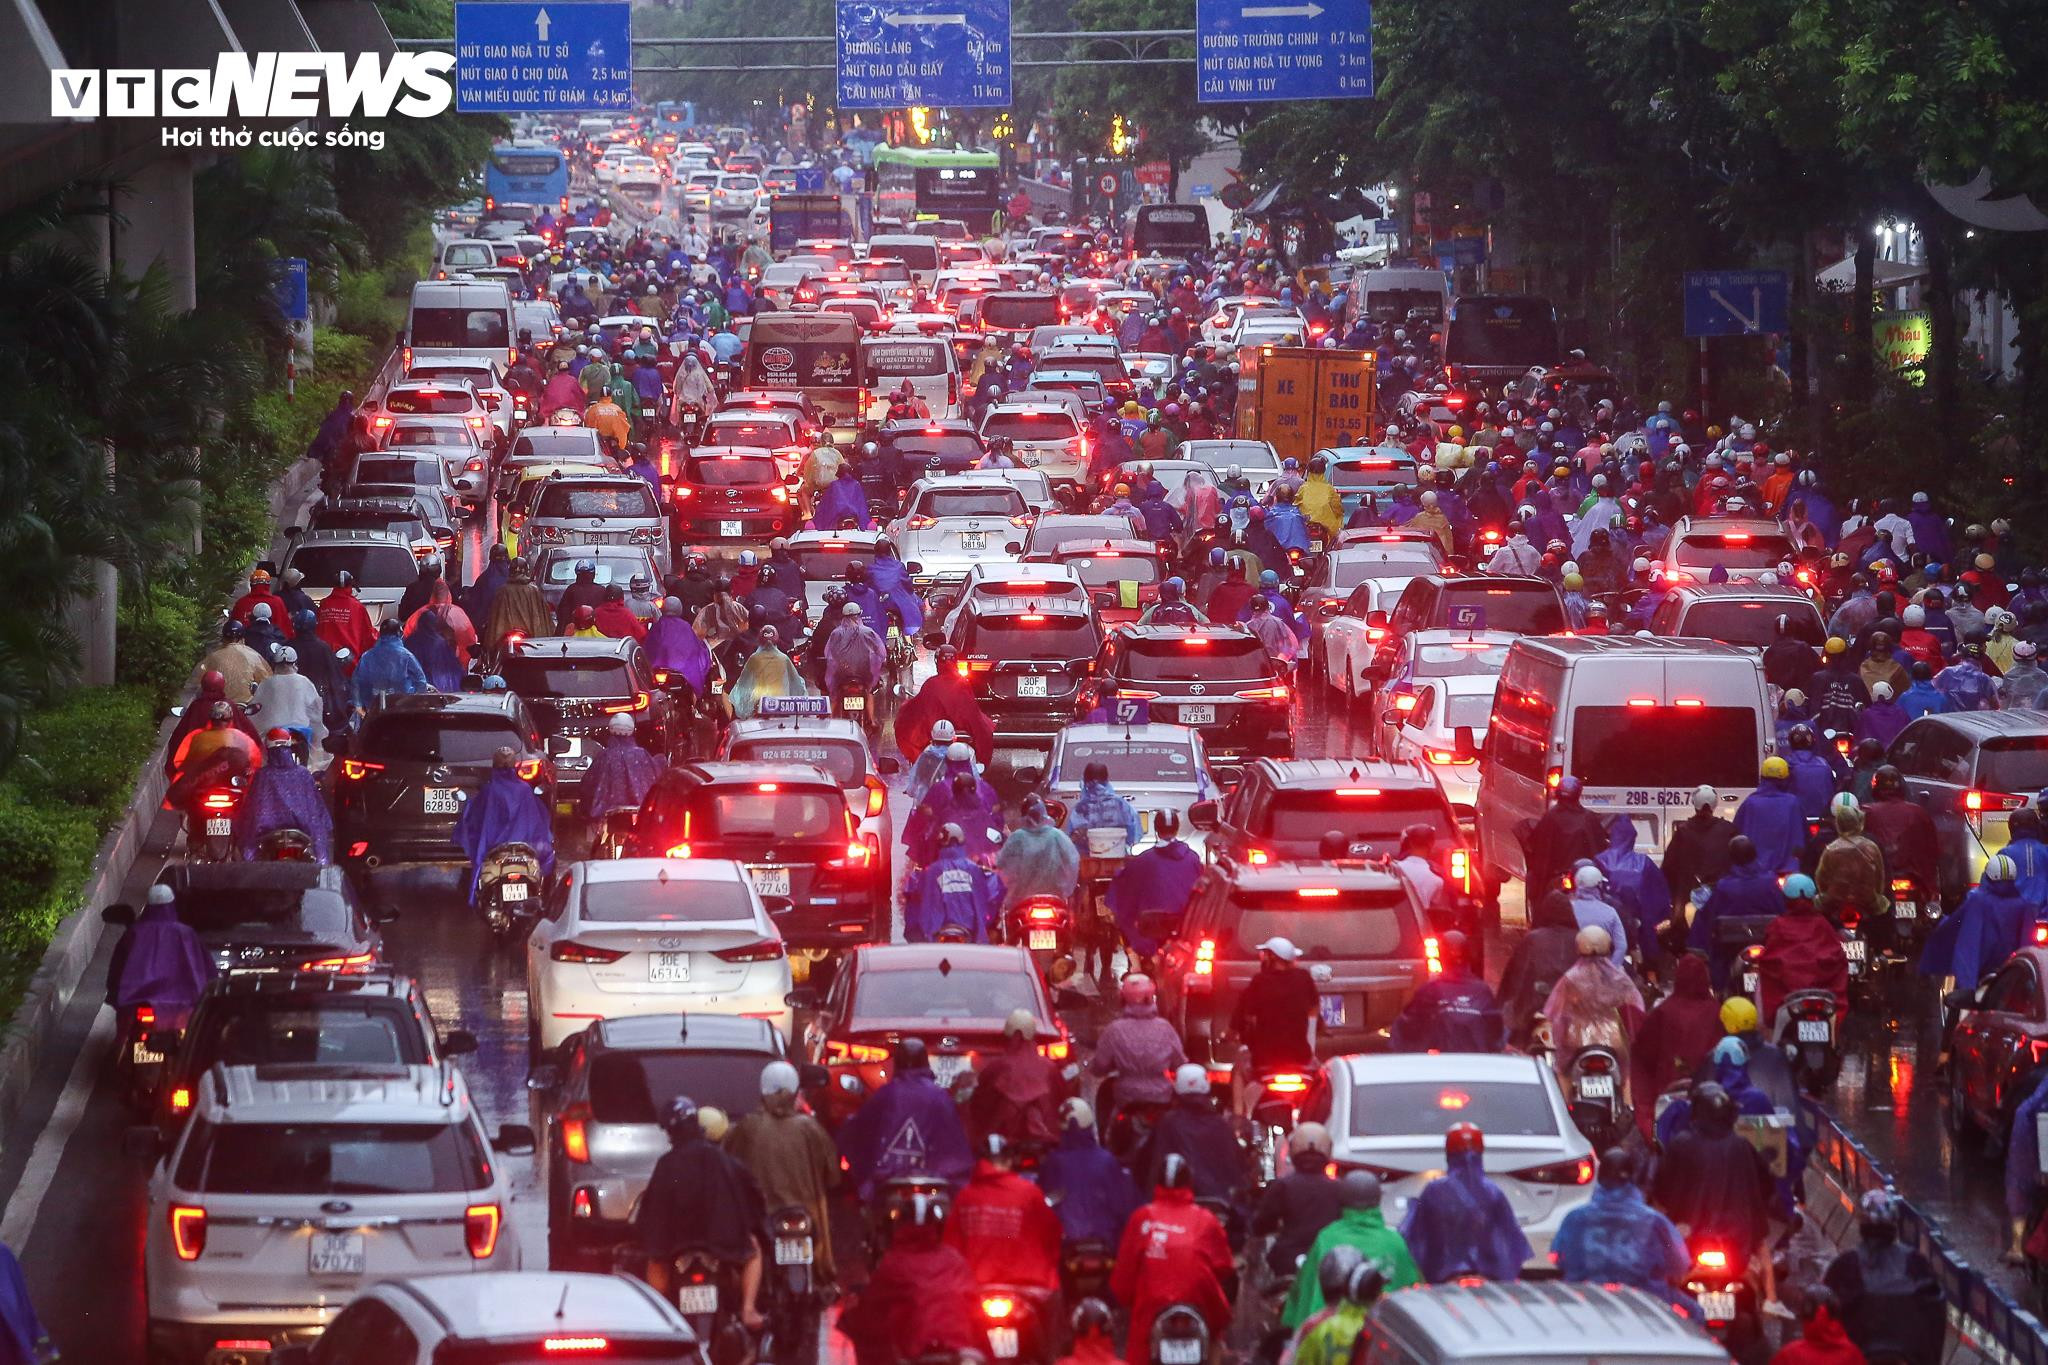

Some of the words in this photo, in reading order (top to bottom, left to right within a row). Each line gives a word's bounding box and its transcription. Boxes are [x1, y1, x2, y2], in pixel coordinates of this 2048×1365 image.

[986, 40, 1002, 53] km
[1203, 31, 1239, 48] ĐƯỜNG
[1243, 30, 1283, 47] TRƯỜNG
[1287, 32, 1318, 46] CHINH
[1349, 31, 1366, 44] km
[460, 42, 480, 58] NÚT
[484, 45, 508, 58] GIAO
[511, 42, 533, 58] NGÃ
[537, 45, 551, 58] TƯ
[556, 41, 569, 58] SỞ
[869, 63, 893, 77] GIAO
[976, 64, 982, 75] 5
[986, 63, 1002, 75] km
[1204, 53, 1224, 71] NÚT
[1227, 56, 1250, 70] GIAO
[1253, 53, 1275, 69] NGÃ
[1295, 54, 1323, 70] VỌNG
[1340, 54, 1346, 66] 3
[1350, 54, 1366, 66] km
[461, 64, 480, 81] NÚT
[484, 67, 508, 81] GIAO
[522, 67, 543, 84] CHỢ
[611, 67, 627, 80] km
[972, 86, 983, 98] 11
[986, 85, 1002, 97] km
[1204, 75, 1224, 93] CẦU
[1257, 78, 1277, 92] TUY
[1340, 76, 1346, 88] 8
[1350, 76, 1366, 88] km
[485, 86, 509, 103] MIẾU
[512, 85, 540, 103] QUỐC
[543, 86, 557, 103] TỬ
[560, 86, 585, 103] GIÁM
[611, 90, 627, 103] km
[1278, 379, 1296, 395] XE
[1024, 677, 1040, 686] 30F
[780, 701, 795, 712] SAO
[432, 789, 450, 800] 30E
